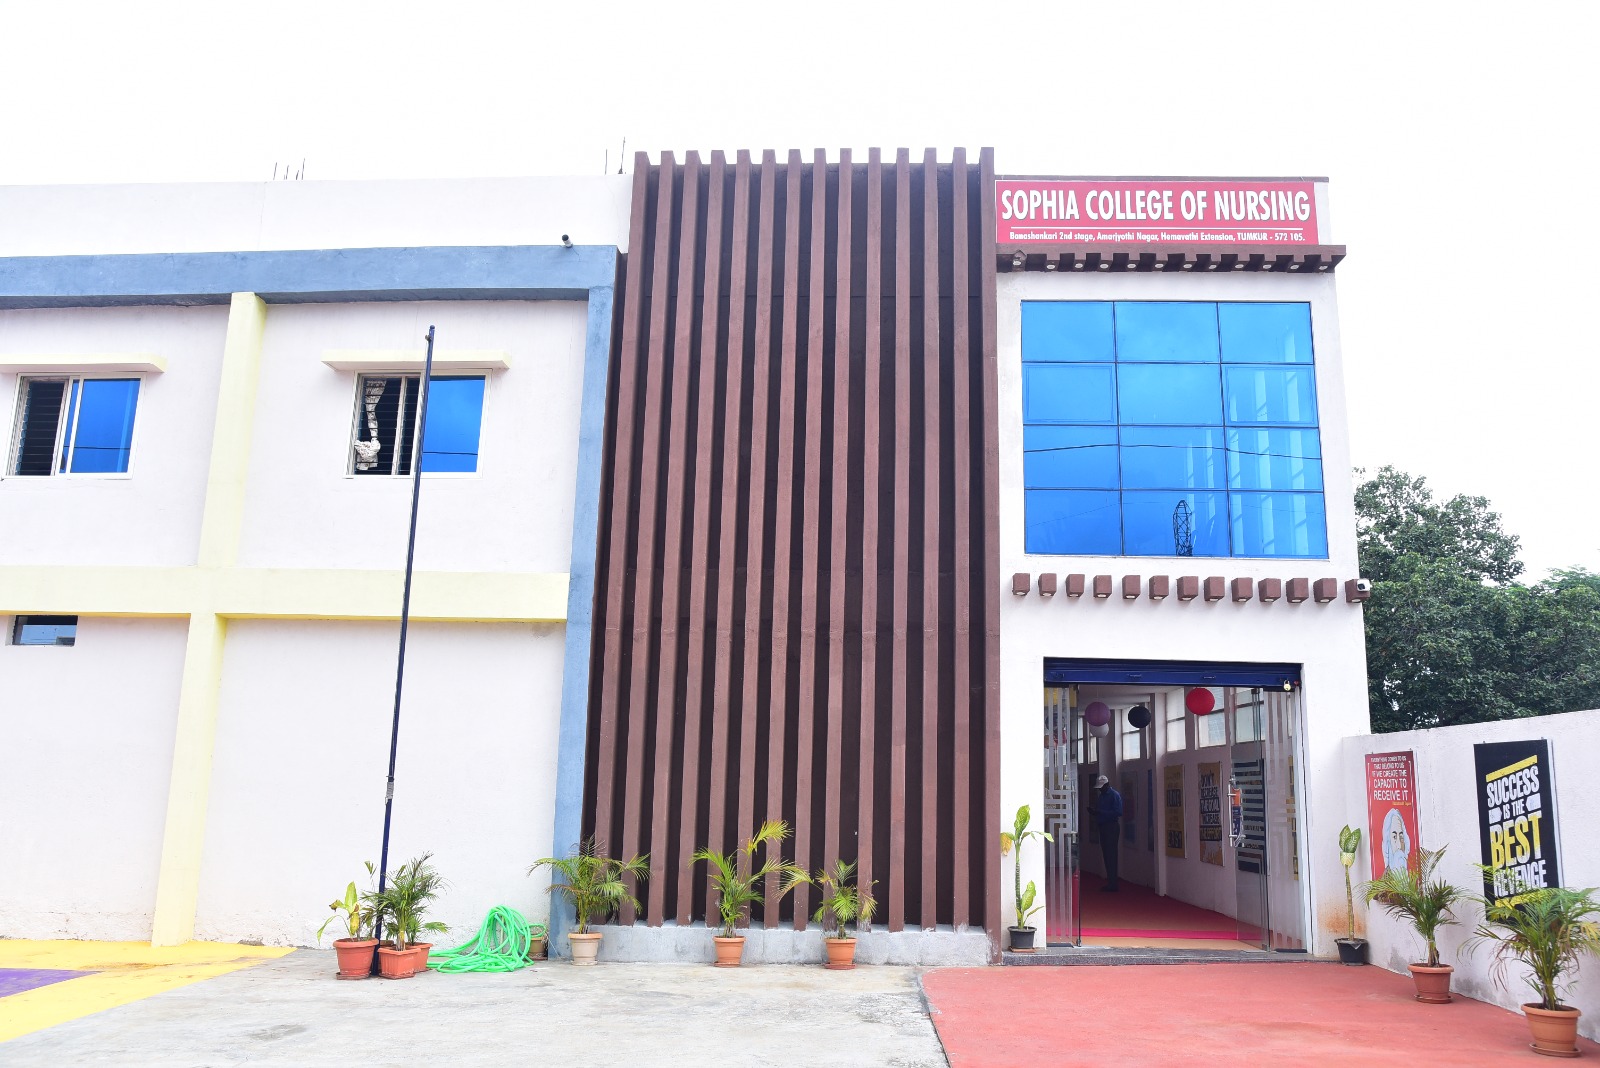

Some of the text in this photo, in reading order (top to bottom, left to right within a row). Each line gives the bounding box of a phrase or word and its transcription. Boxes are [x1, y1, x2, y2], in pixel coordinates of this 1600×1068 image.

[1001, 189, 1311, 221] SOPHIA COLLEGE OF NURSING
[1059, 231, 1072, 240] 2nd
[1074, 232, 1095, 242] stage,
[1097, 231, 1135, 242] Amarjyothi
[1137, 231, 1159, 242] Nagar,
[1161, 232, 1198, 241] Hemavathi
[1201, 232, 1235, 242] Extension,
[1237, 232, 1268, 241] TUMKUR
[1274, 232, 1288, 241] 572
[1290, 232, 1305, 241] 105.
[1374, 779, 1406, 788] CAPACITY TO
[1374, 790, 1408, 800] RECEIVE IT
[1486, 765, 1540, 808] SUCCESS
[1503, 798, 1526, 820] IS THE
[1489, 810, 1542, 870] BEST
[1493, 859, 1547, 898] REVENGE
